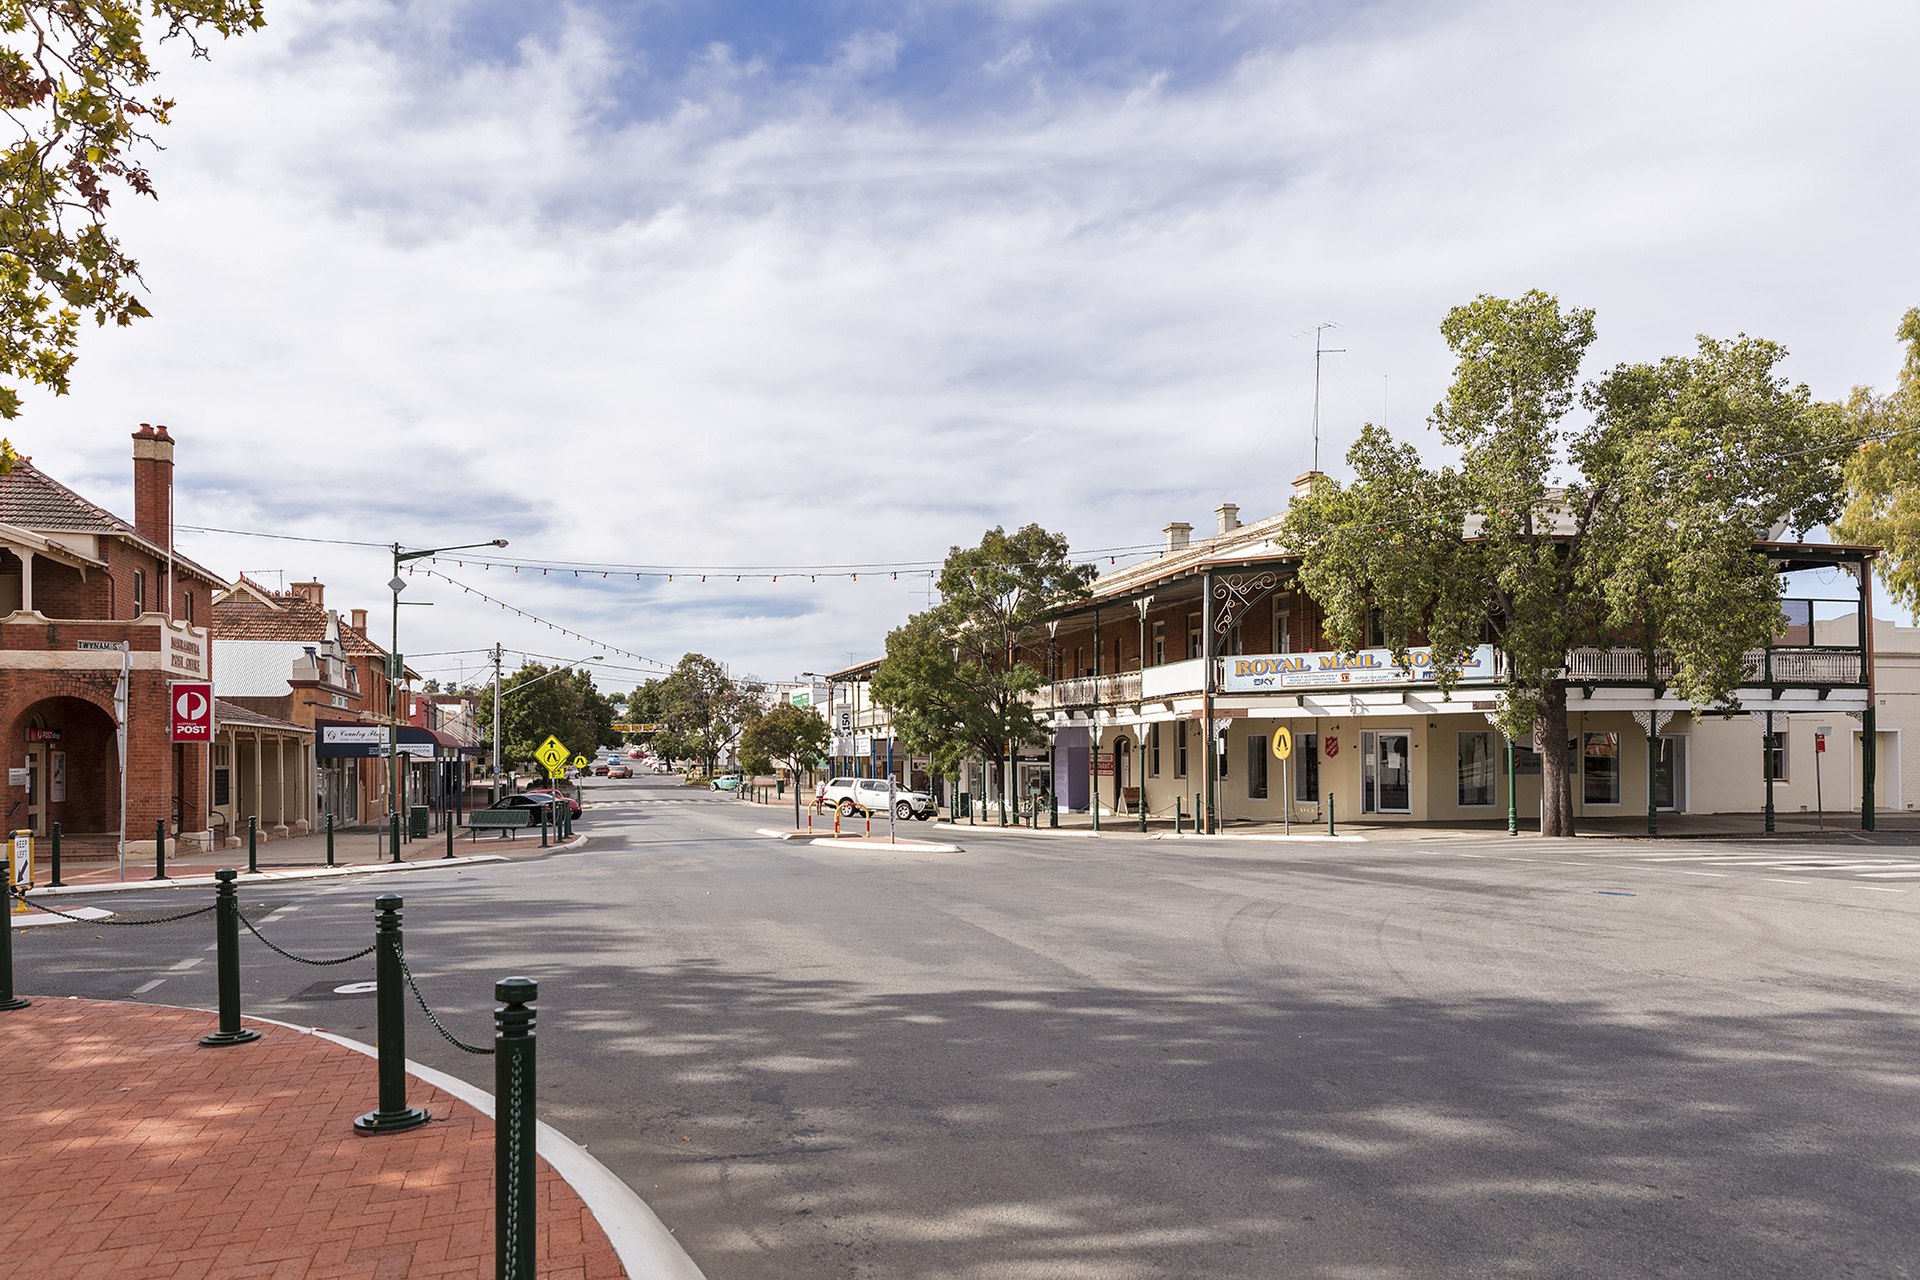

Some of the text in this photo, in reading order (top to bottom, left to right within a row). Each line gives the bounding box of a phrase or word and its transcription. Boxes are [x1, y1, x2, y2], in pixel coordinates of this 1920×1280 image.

[79, 641, 110, 650] TWYNAM
[1235, 650, 1482, 677] ROYAL MAIL HOL
[1253, 676, 1275, 686] SKY
[842, 712, 851, 731] 150
[177, 725, 207, 734] POST
[17, 840, 28, 848] KEEP
[17, 850, 28, 858] LEFT
